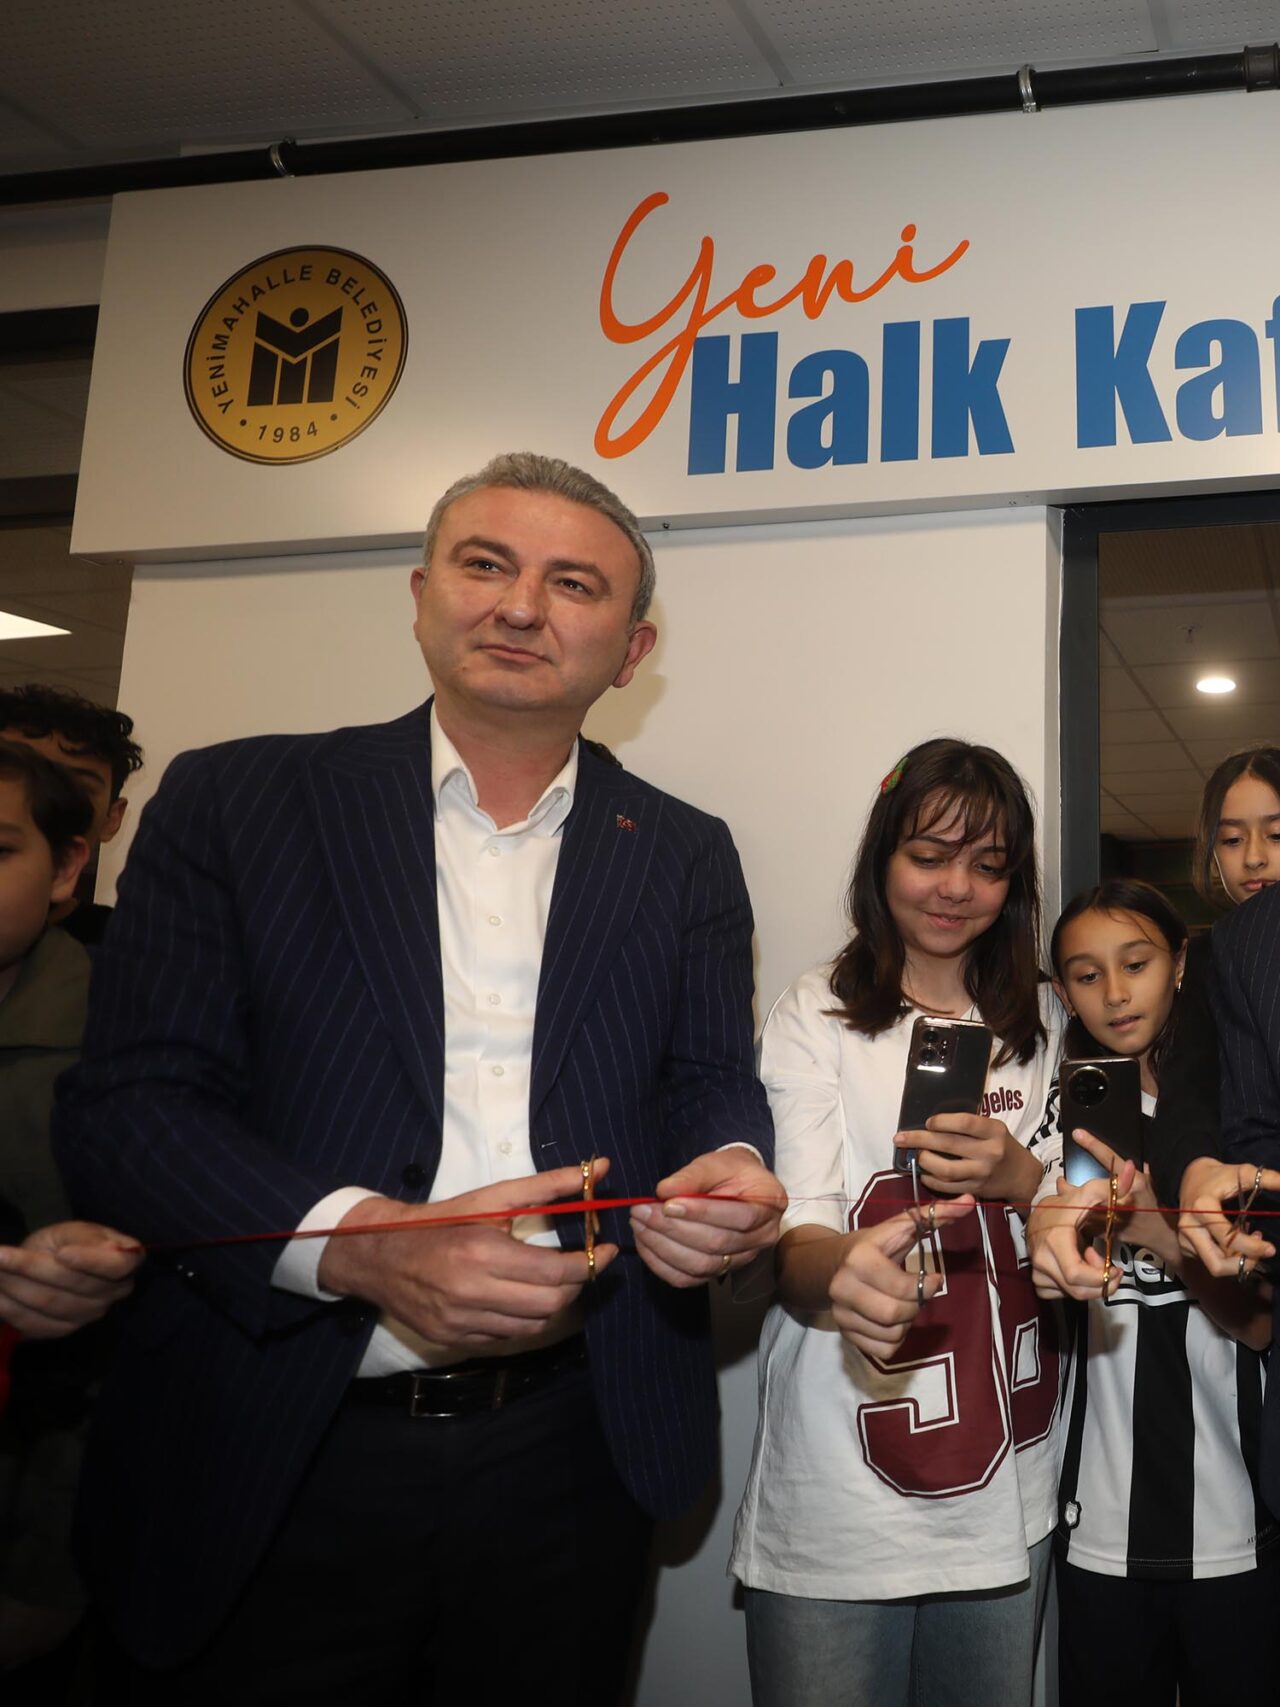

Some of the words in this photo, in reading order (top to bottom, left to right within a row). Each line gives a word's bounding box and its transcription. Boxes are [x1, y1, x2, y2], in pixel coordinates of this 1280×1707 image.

[206, 265, 313, 414] YENİMAHALLE
[325, 268, 387, 409] BELEDİYESİ
[594, 191, 970, 460] Yeni
[687, 316, 1016, 476] Halk
[258, 421, 318, 443] 1984
